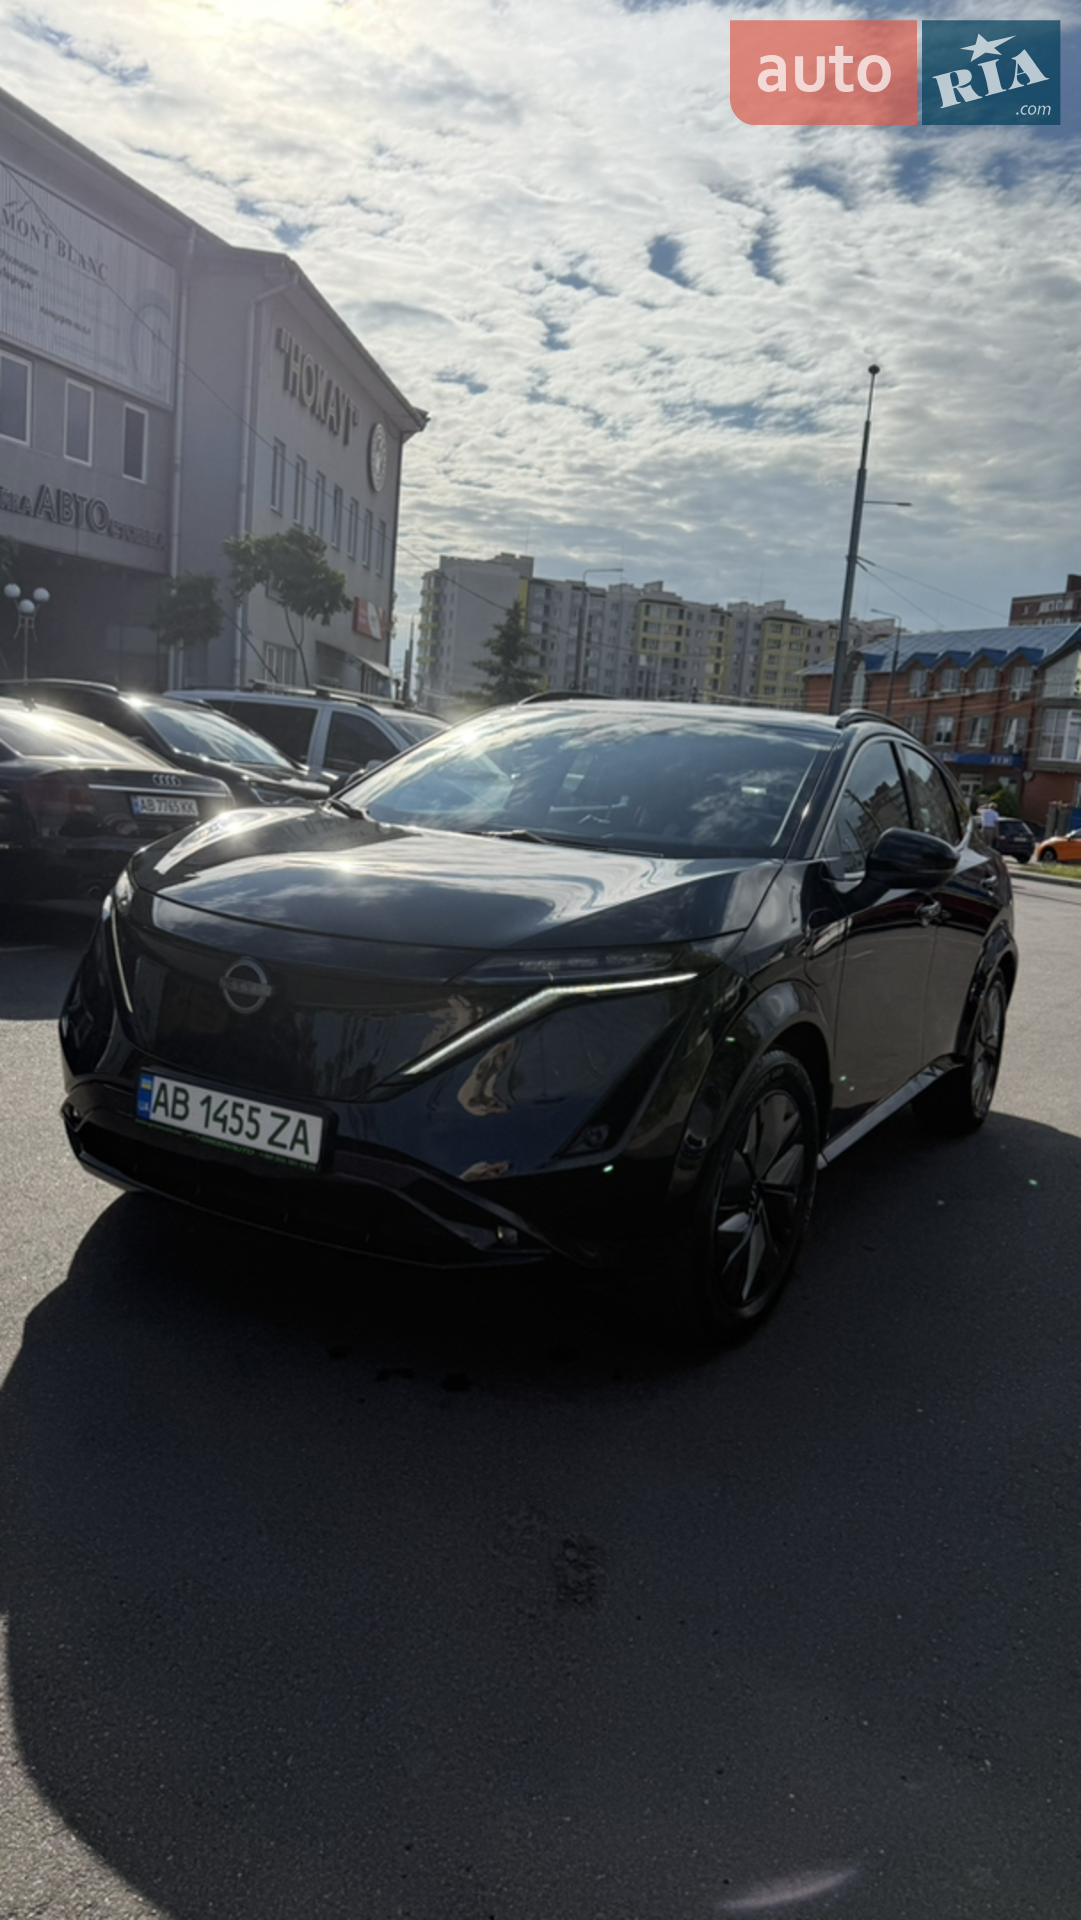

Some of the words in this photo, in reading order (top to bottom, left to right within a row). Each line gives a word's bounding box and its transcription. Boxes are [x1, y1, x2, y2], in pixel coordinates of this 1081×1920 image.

[1, 206, 51, 250] MONT
[57, 239, 109, 282] BLANC
[152, 1082, 190, 1121] AB
[200, 1094, 261, 1141] 1455
[267, 1111, 310, 1156] ZA
